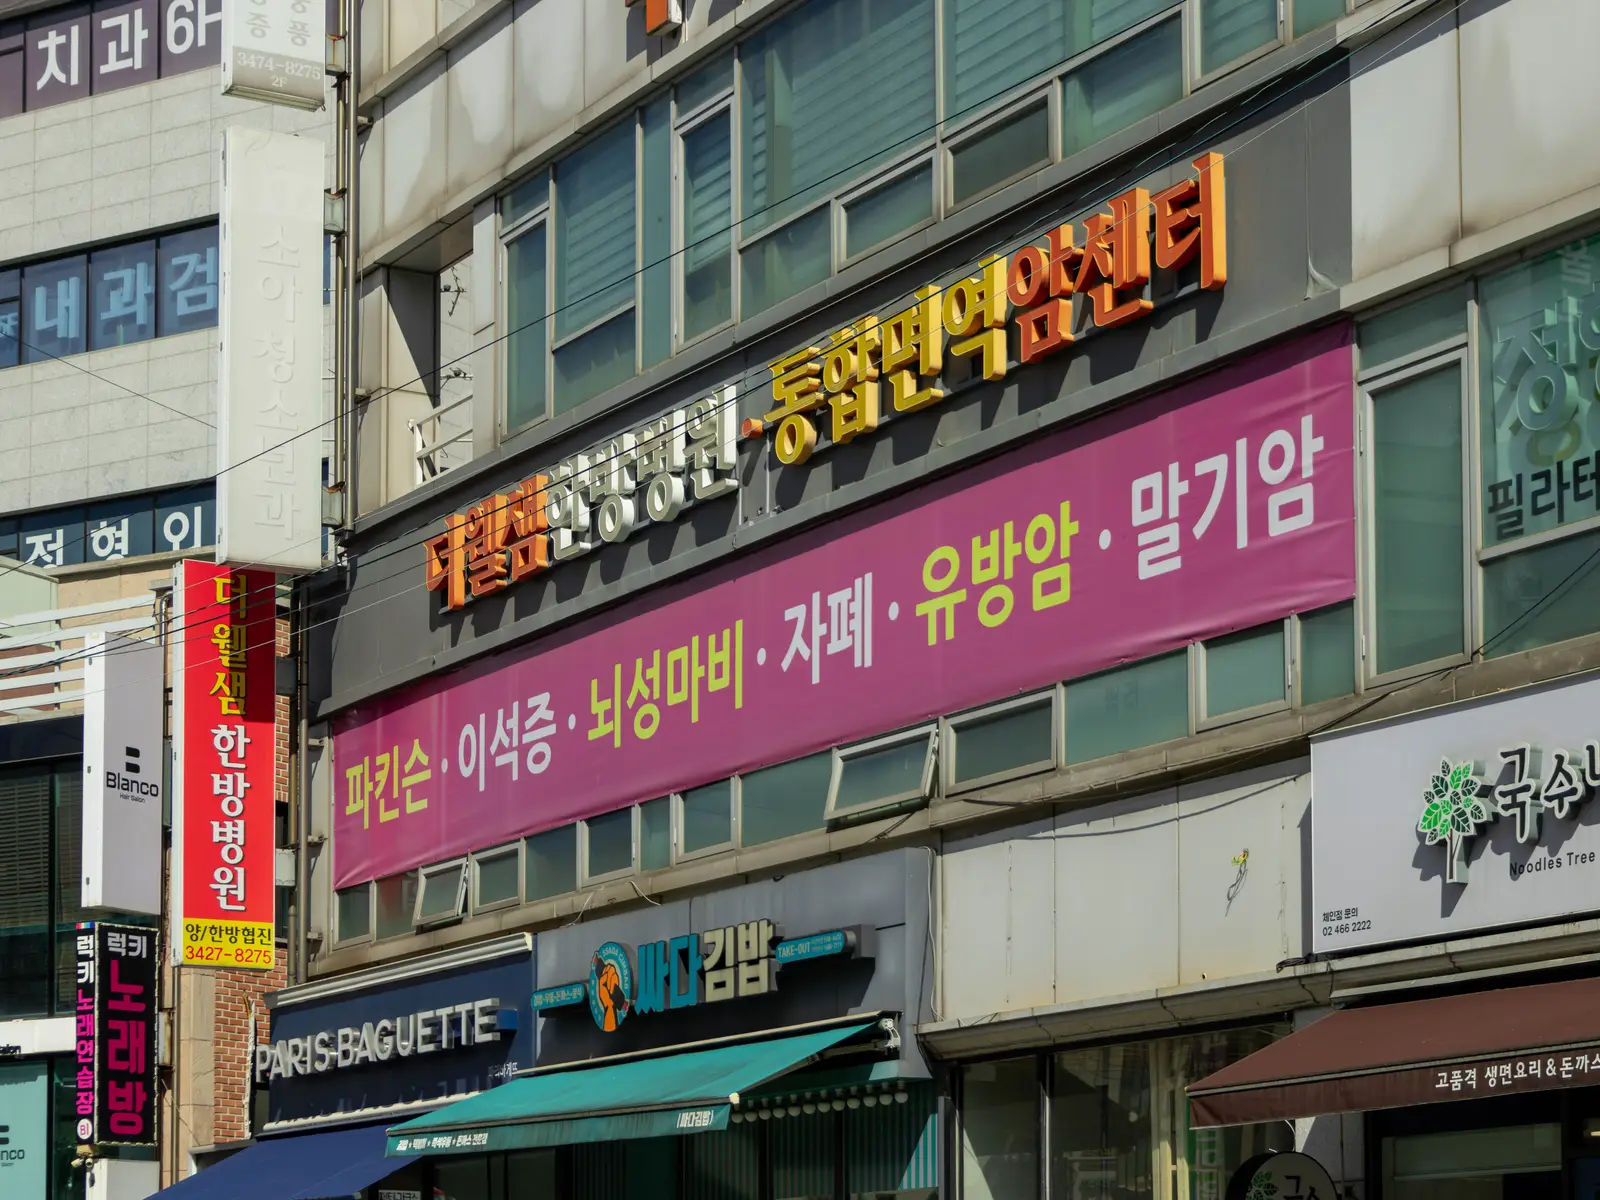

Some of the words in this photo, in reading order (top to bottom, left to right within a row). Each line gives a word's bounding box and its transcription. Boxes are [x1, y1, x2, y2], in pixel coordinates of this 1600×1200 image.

[37, 8, 149, 90] 치과
[237, 51, 321, 80] 3474-8275
[271, 75, 287, 88] 2F
[345, 737, 432, 829] 파킨슨
[458, 691, 557, 791] 이석증
[587, 619, 744, 749] 뇌성마비
[780, 571, 873, 684] 자폐
[915, 500, 1079, 646] 유방암
[1131, 414, 1324, 580] 말기암
[106, 771, 159, 797] Blanco
[1509, 857, 1562, 877] Noodles
[1566, 851, 1596, 866] Tree
[1344, 907, 1358, 919] 문의
[185, 924, 272, 946] 양/한방협진
[1322, 926, 1333, 936] 02
[1334, 923, 1350, 934] 466
[1352, 920, 1372, 932] 2222
[107, 932, 147, 958] 럭키
[185, 945, 272, 964] 3427-8275
[777, 941, 811, 958] TAKE-OUT
[107, 959, 147, 1135] 노래방
[255, 1030, 336, 1083] PARIS
[337, 997, 500, 1068] BAGUETTE
[1435, 1068, 1477, 1091] 고품격
[1484, 1059, 1541, 1087] 생면요리
[1545, 1058, 1557, 1076] &
